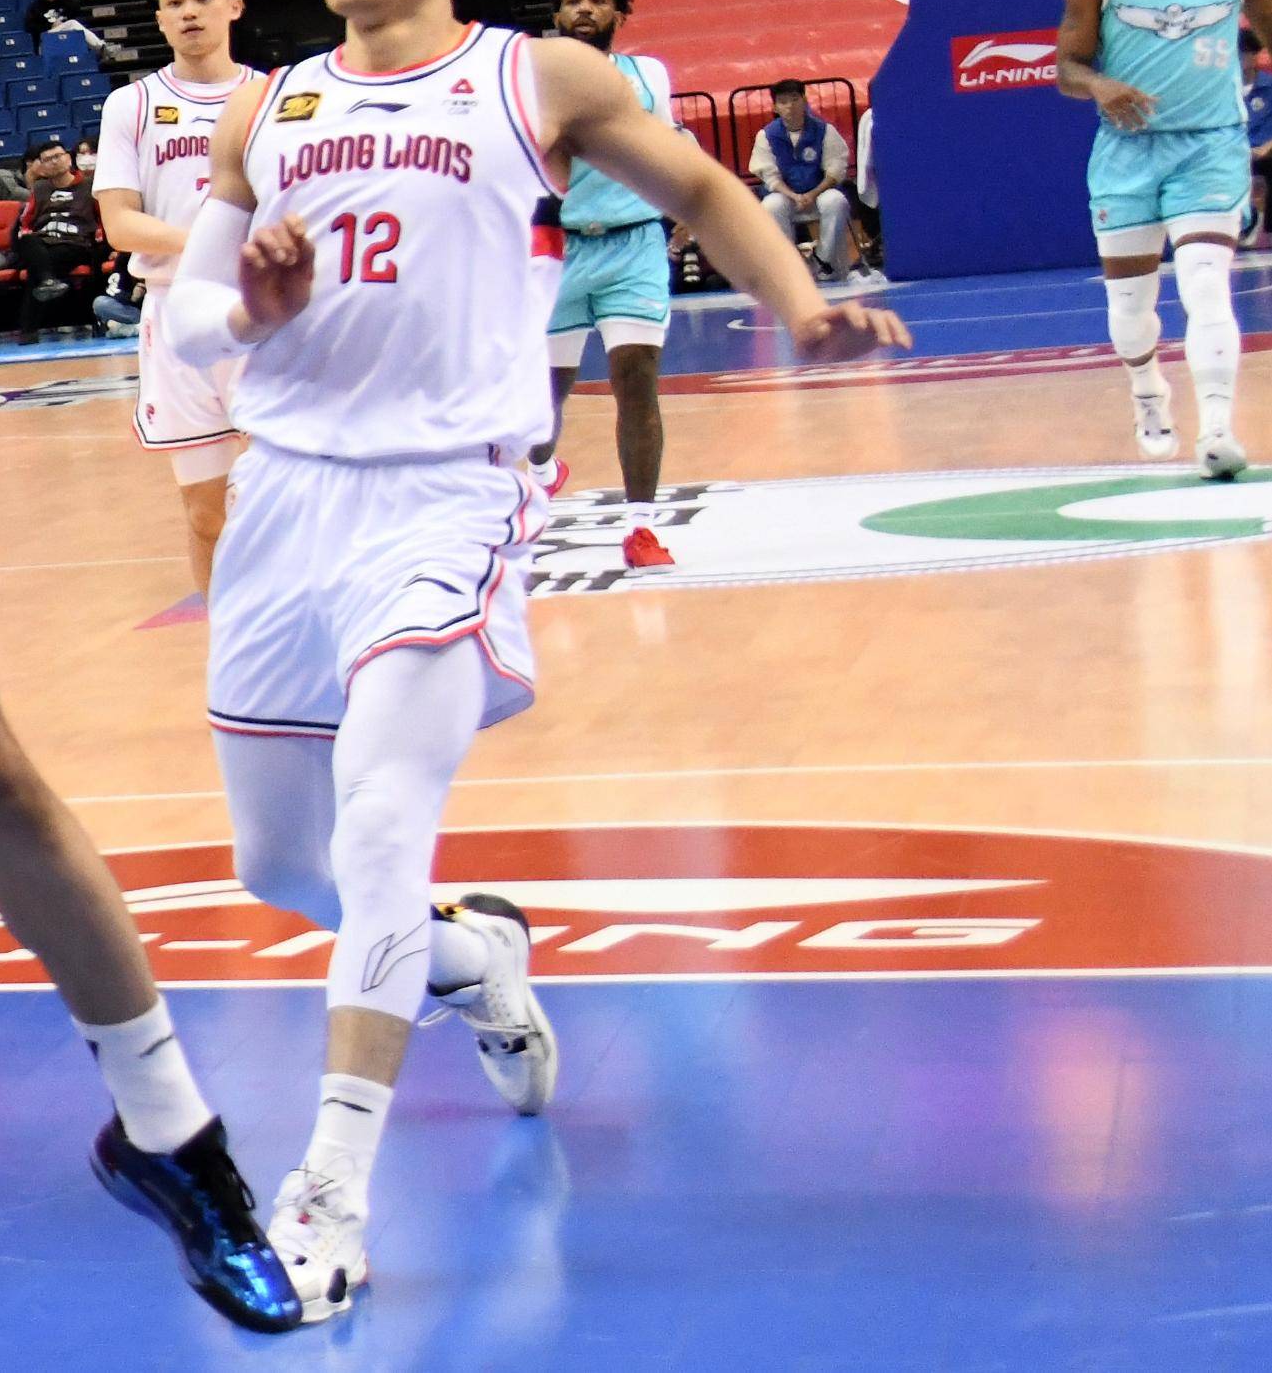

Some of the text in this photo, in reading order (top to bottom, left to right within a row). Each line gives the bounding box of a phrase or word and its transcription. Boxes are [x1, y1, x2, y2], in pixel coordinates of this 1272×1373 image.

[959, 64, 1058, 87] LI-NING
[155, 135, 210, 166] LOONG
[279, 132, 473, 192] LOONG LIONS
[329, 211, 402, 284] 12
